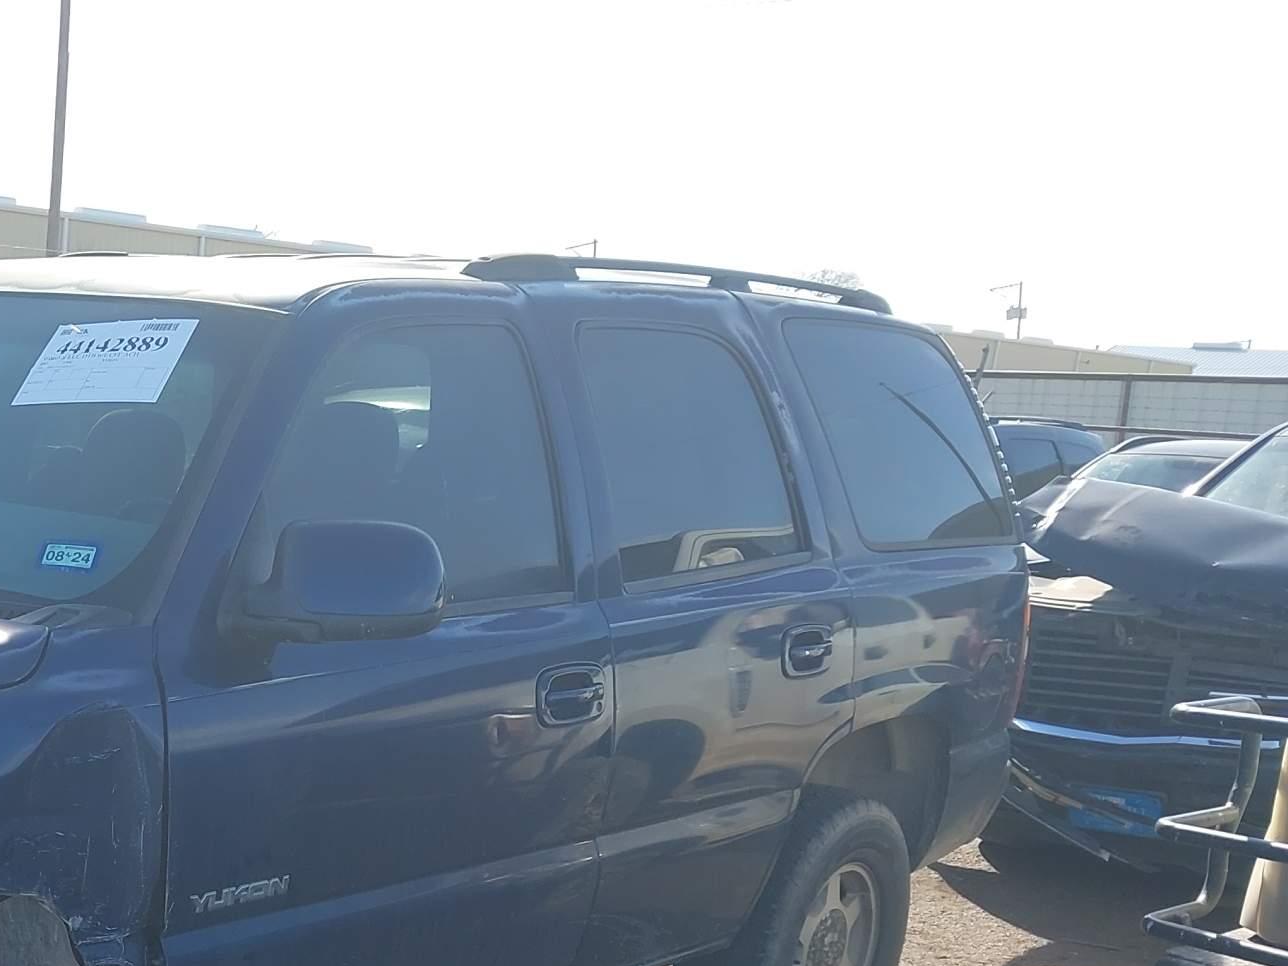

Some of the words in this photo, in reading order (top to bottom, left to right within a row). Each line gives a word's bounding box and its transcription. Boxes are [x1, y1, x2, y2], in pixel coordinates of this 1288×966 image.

[56, 336, 169, 355] 44142889
[46, 550, 65, 562] 08
[71, 551, 91, 564] 24
[190, 874, 290, 913] YUKON
